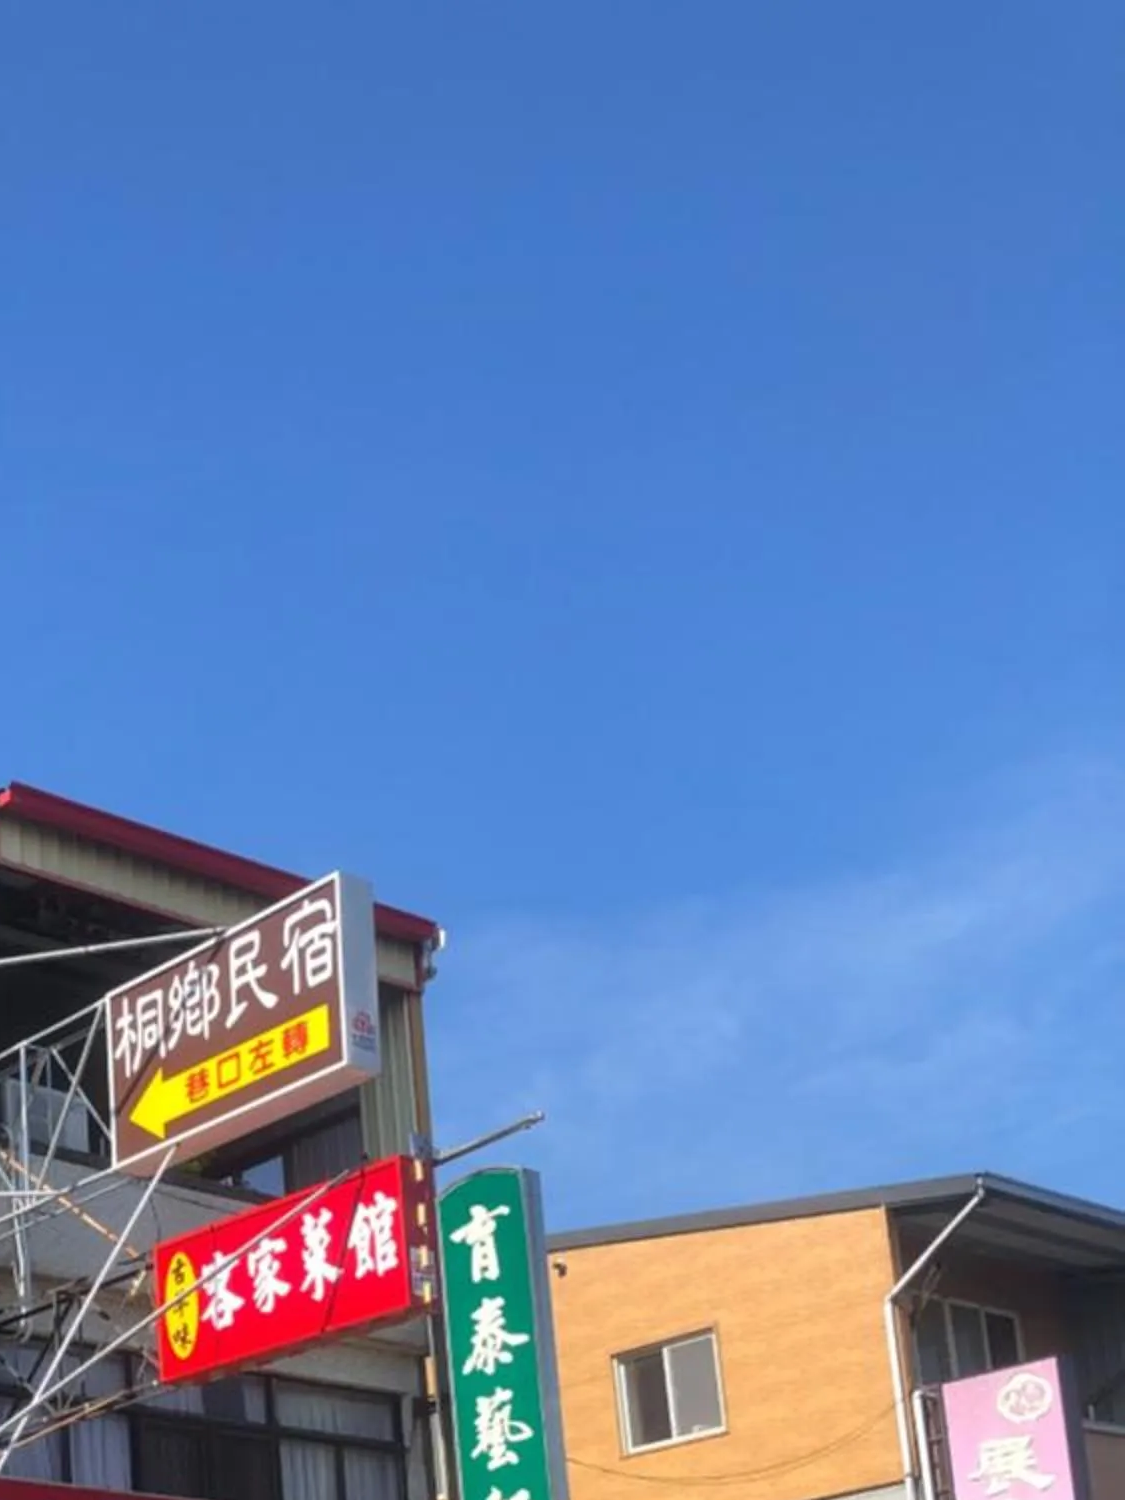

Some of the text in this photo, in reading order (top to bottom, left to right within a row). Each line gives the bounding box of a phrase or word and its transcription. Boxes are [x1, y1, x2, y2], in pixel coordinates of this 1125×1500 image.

[115, 898, 336, 1079] 桐鄉民宿
[186, 1020, 309, 1103] 巷口左轉
[201, 1192, 399, 1331] 客家菜館
